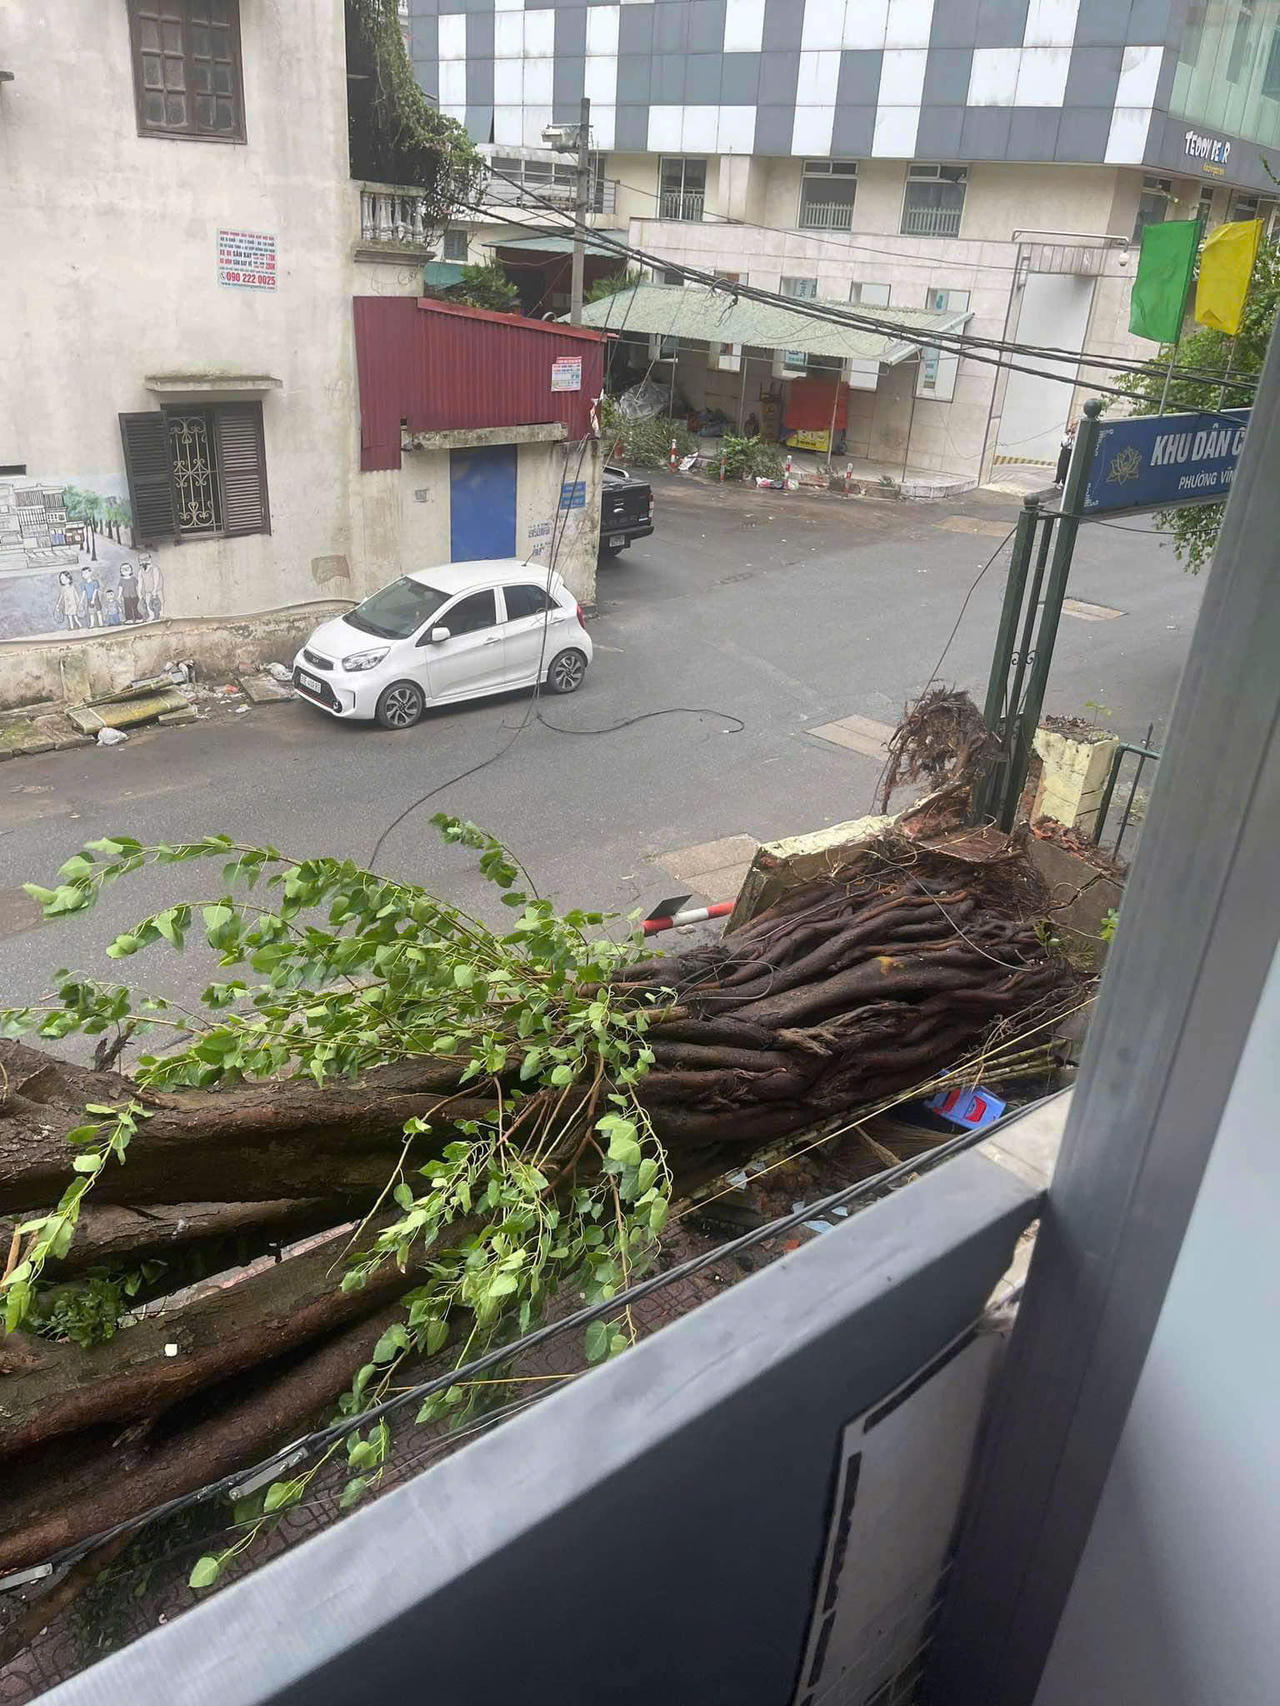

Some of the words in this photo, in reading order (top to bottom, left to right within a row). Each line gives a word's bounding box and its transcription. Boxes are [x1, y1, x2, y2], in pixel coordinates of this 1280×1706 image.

[1185, 130, 1212, 159] TEDDY
[233, 249, 243, 258] SÂN
[242, 273, 256, 283] 222
[258, 275, 275, 285] 0025
[1150, 432, 1193, 466] KHU
[1191, 422, 1232, 461] DÂN
[1232, 427, 1247, 455] C
[1178, 469, 1218, 490] PHƯỜNG
[1220, 467, 1237, 483] VĨN
